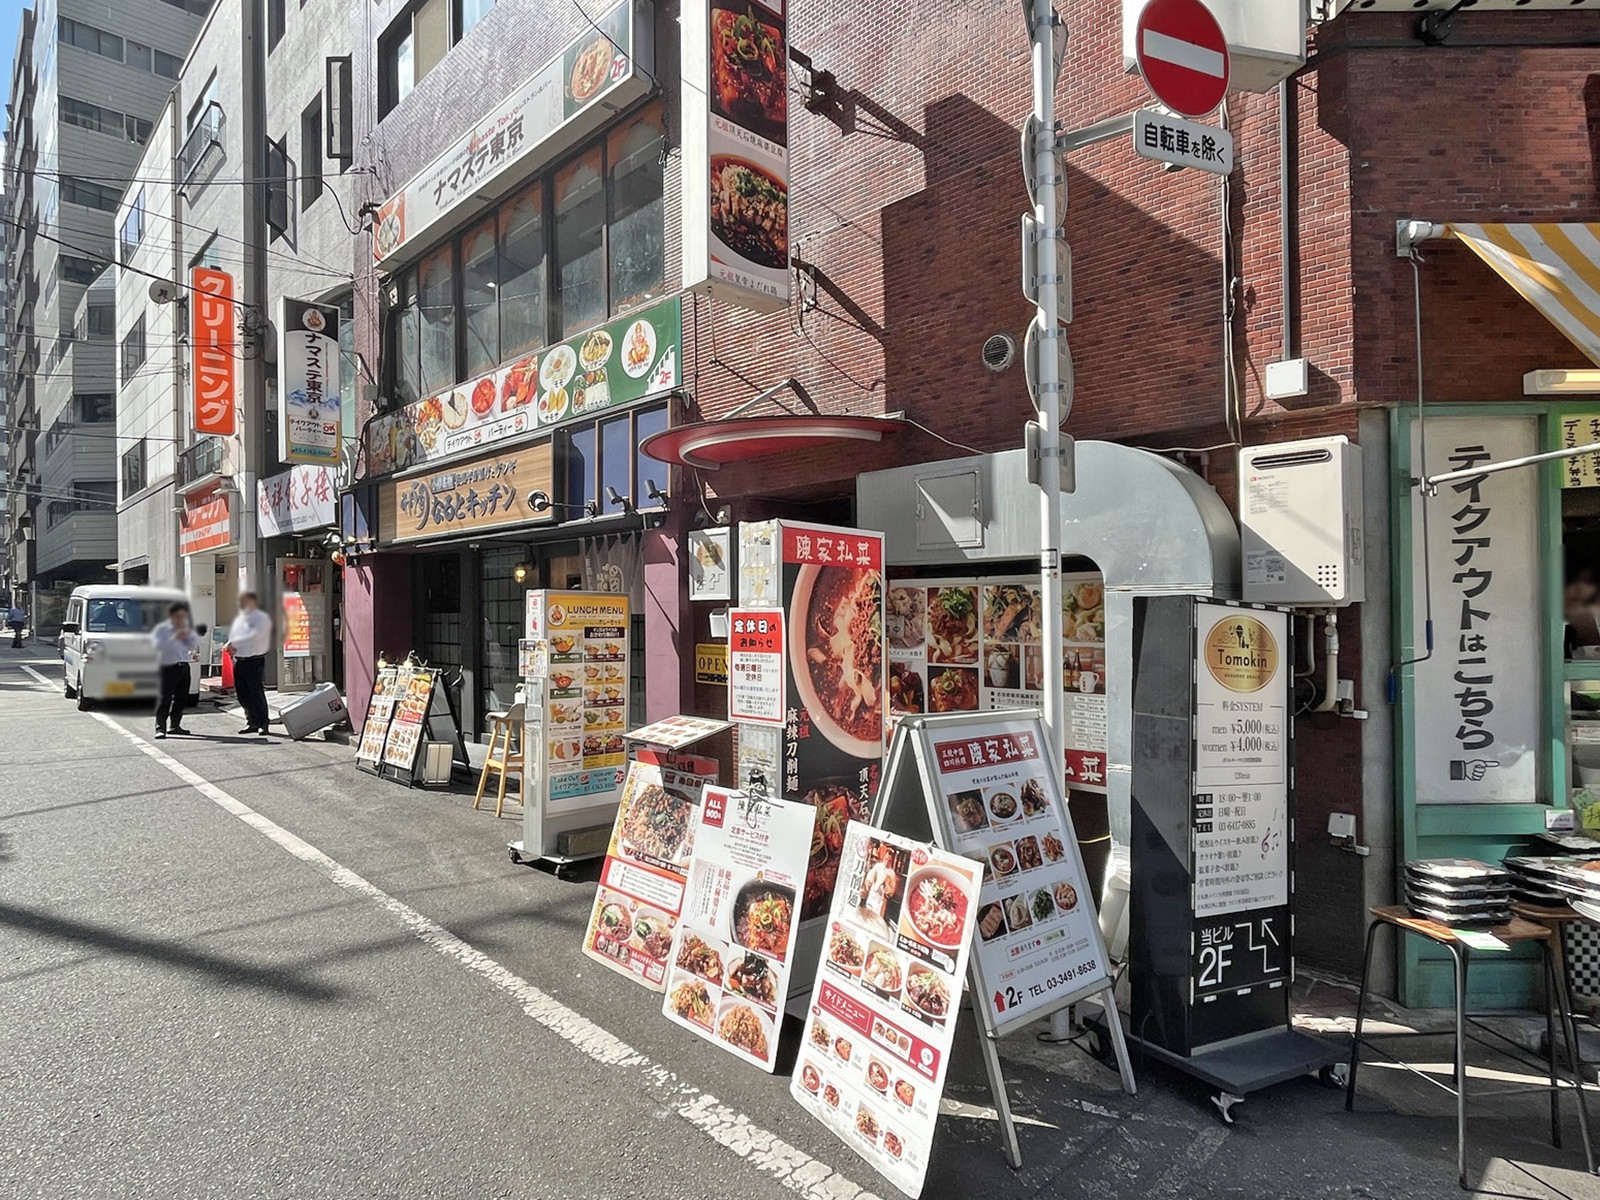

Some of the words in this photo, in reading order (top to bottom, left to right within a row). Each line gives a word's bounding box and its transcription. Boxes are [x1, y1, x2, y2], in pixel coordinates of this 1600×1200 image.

[610, 58, 626, 80] 2F
[1144, 122, 1225, 165] 自転車を除く
[433, 114, 525, 206] ナマステ東京
[200, 275, 231, 426] クリーニング
[305, 333, 323, 404] ナマステ東京
[659, 370, 672, 385] 2F
[487, 423, 513, 438] パーティー
[431, 481, 518, 526] なるとキッチン
[795, 534, 872, 566] 陳家私菜
[567, 605, 598, 614] LUNCH
[600, 605, 624, 615] MENU
[734, 619, 777, 634] 定休日の
[740, 637, 774, 648] お知らせ
[735, 663, 762, 673] 毎週日曜日
[1217, 648, 1268, 668] Tomokin
[745, 673, 763, 682] 定休日
[1212, 726, 1228, 734] men
[1231, 719, 1262, 734] ¥5,000
[785, 706, 801, 793] 麻辣刀削麺
[967, 735, 1035, 766] 陳家私菜
[1201, 744, 1228, 752] women
[1230, 736, 1262, 752] ¥4,000
[708, 799, 722, 809] ALL
[1197, 824, 1211, 832] TEL
[1201, 926, 1235, 946] 当ビル
[1199, 944, 1234, 987] 2F
[1005, 985, 1024, 1009] 2F
[1046, 959, 1097, 990] 03-3491-8638
[825, 989, 866, 1020] サイドメニュー
